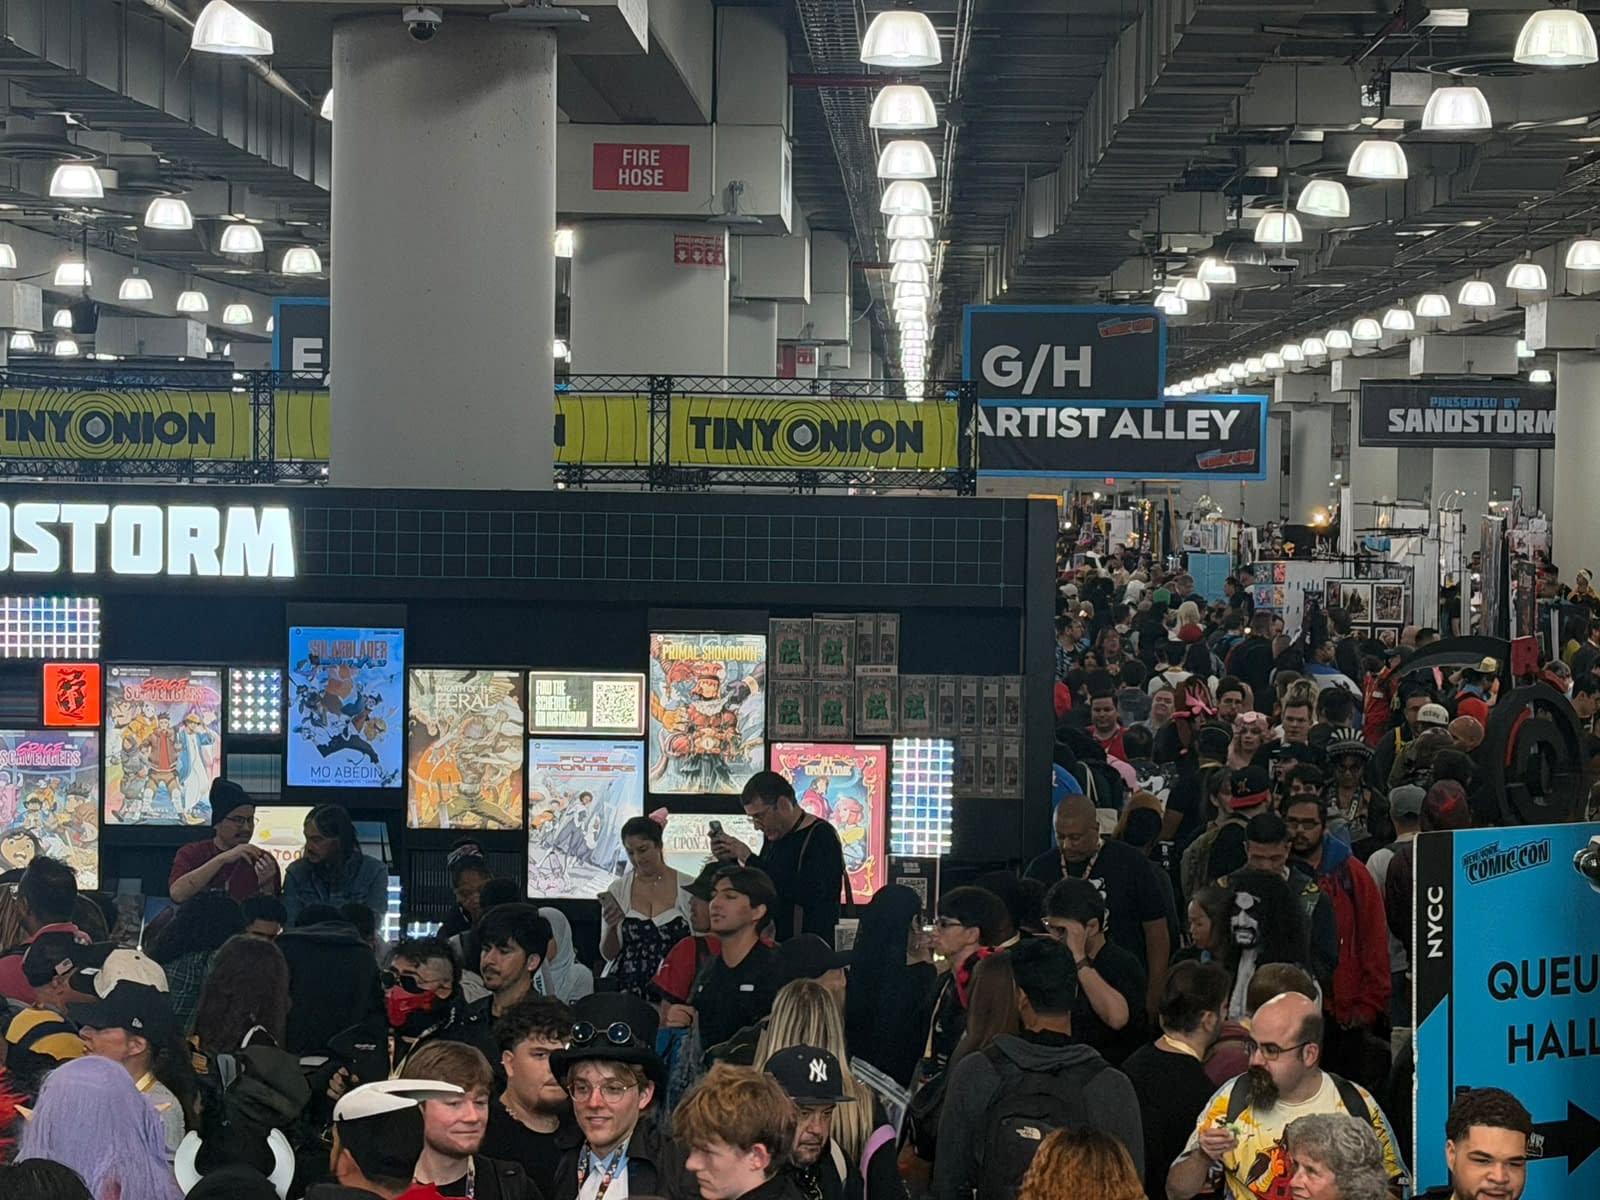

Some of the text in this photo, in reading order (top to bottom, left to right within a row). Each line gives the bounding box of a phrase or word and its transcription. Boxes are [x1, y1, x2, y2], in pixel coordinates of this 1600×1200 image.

[622, 149, 661, 167] FIRE
[618, 168, 664, 186] HOSE
[981, 343, 1093, 396] G/H
[1429, 396, 1521, 409] PRESENTED BY
[965, 406, 1241, 440] ARTIST ALLEY
[1388, 408, 1555, 434] SANDSTORM
[0, 502, 296, 578] STORM
[662, 644, 698, 661] PRIMAL
[436, 693, 497, 710] FERAL
[536, 763, 636, 772] FRONTIERS
[559, 755, 608, 763] FOUR
[310, 766, 331, 778] MO
[1468, 840, 1549, 881] COMIC CON
[1427, 886, 1444, 959] NYCC
[1486, 953, 1600, 1002] QUEU
[1507, 1017, 1600, 1065] HALL
